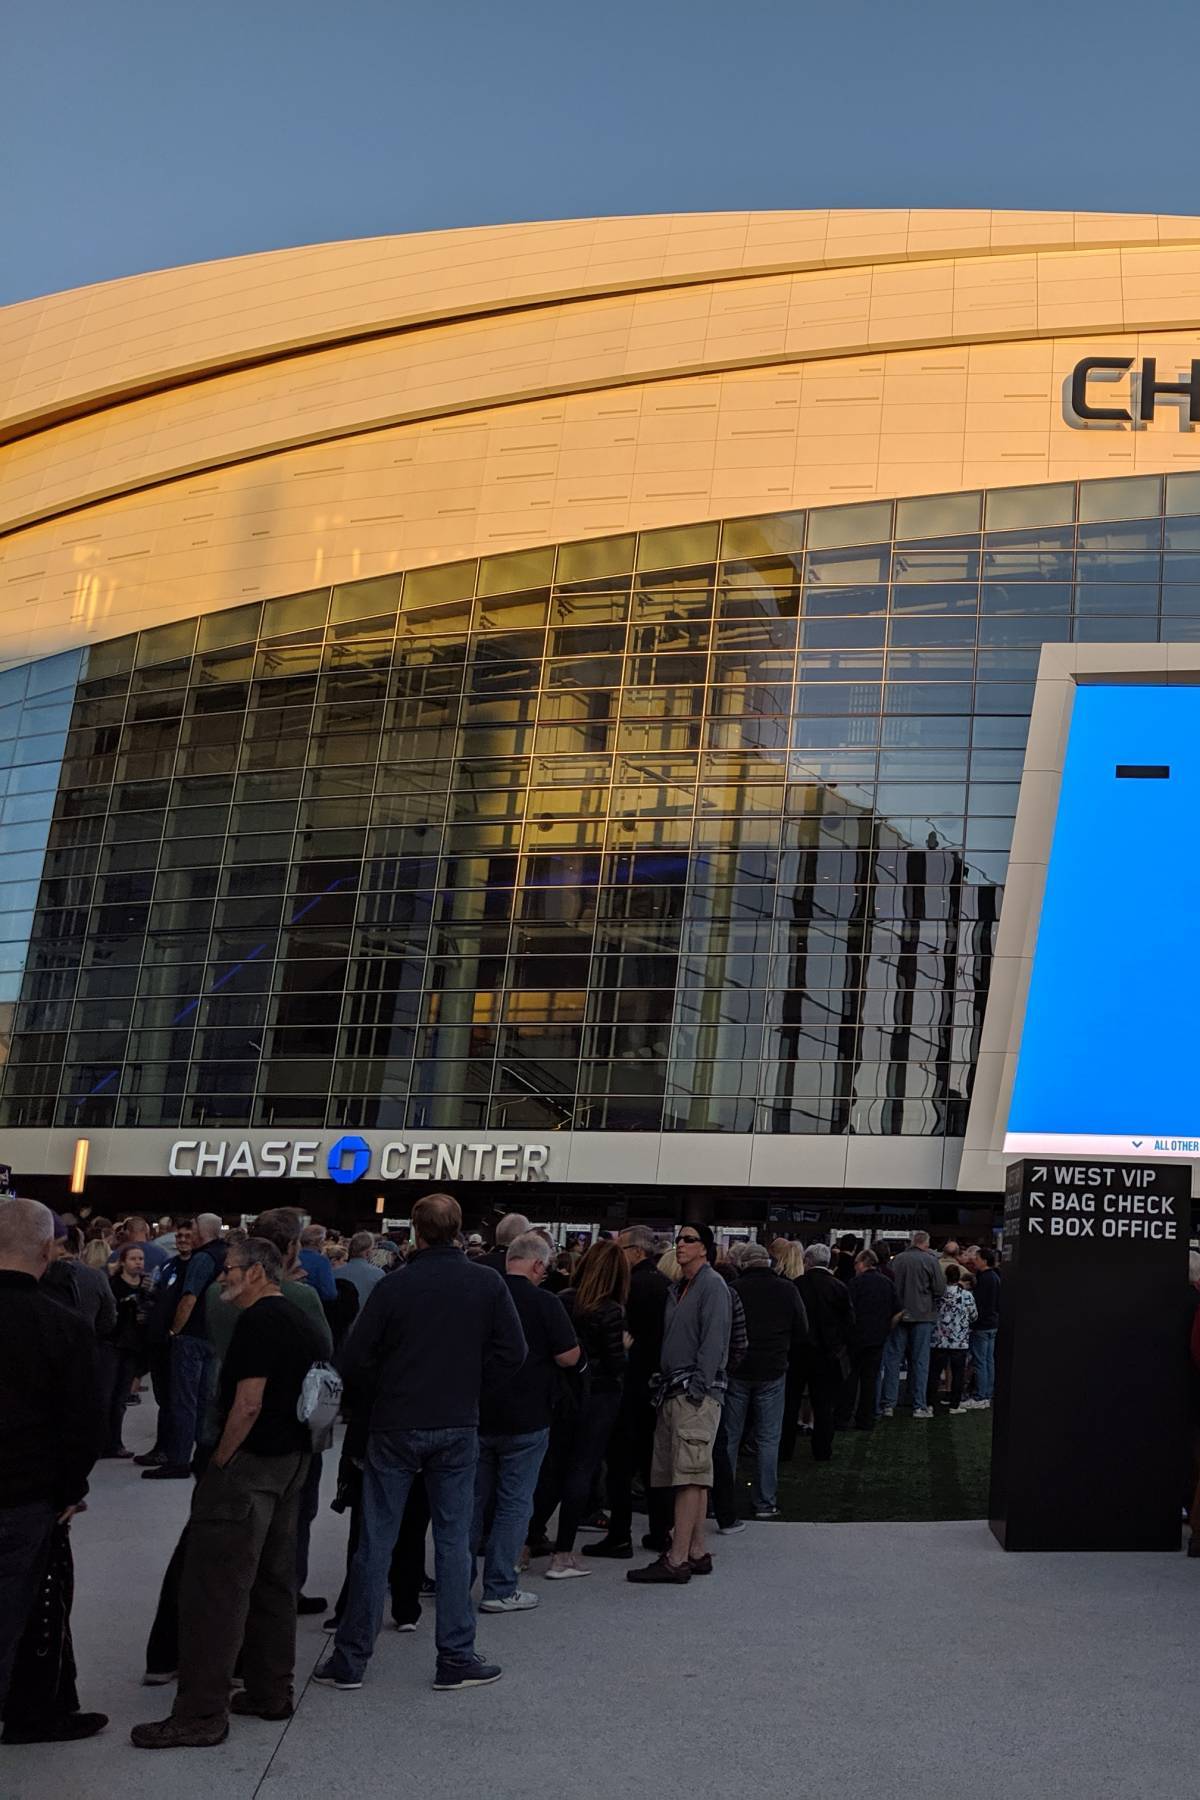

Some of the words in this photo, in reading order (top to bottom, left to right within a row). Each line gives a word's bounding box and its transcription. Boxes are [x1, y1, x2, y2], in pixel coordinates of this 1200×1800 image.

[1154, 1140, 1170, 1152] ALL
[1171, 1140, 1199, 1153] OTHER
[168, 1140, 321, 1179] CHASE
[379, 1142, 551, 1182] CENTER
[1054, 1166, 1115, 1187] WEST
[1121, 1168, 1157, 1188] VIP
[1051, 1192, 1096, 1212] BAG
[1103, 1194, 1176, 1215] CHECK
[1050, 1217, 1096, 1237] BOX
[1102, 1218, 1178, 1240] OFFICE
